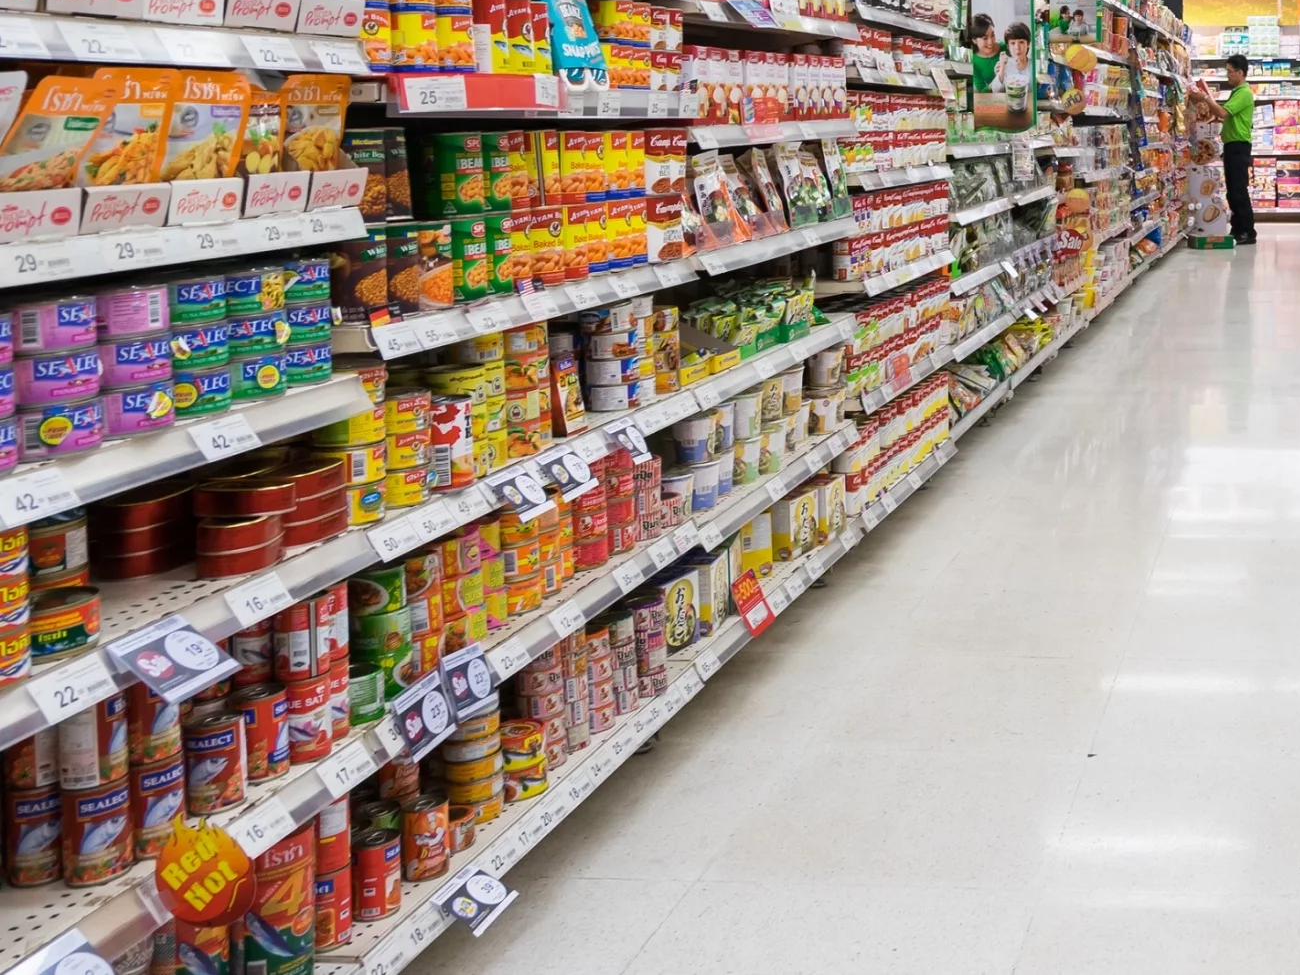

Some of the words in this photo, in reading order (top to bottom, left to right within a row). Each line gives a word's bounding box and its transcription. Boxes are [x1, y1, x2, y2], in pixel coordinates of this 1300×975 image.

[305, 6, 343, 30] Prompt
[420, 90, 438, 106] 25
[90, 192, 142, 223] Prompt
[176, 187, 222, 216] Prompt
[265, 225, 281, 242] 29
[310, 218, 324, 233] 29
[197, 232, 214, 249] 29
[115, 242, 135, 260] 29
[15, 254, 37, 274] 29
[212, 435, 230, 450] 42
[15, 494, 38, 512] 42
[246, 597, 264, 614] 16
[54, 685, 79, 708] 22
[246, 824, 264, 843] 16
[160, 830, 221, 891] Red
[183, 860, 238, 912] Hot
[260, 869, 307, 916] 4
